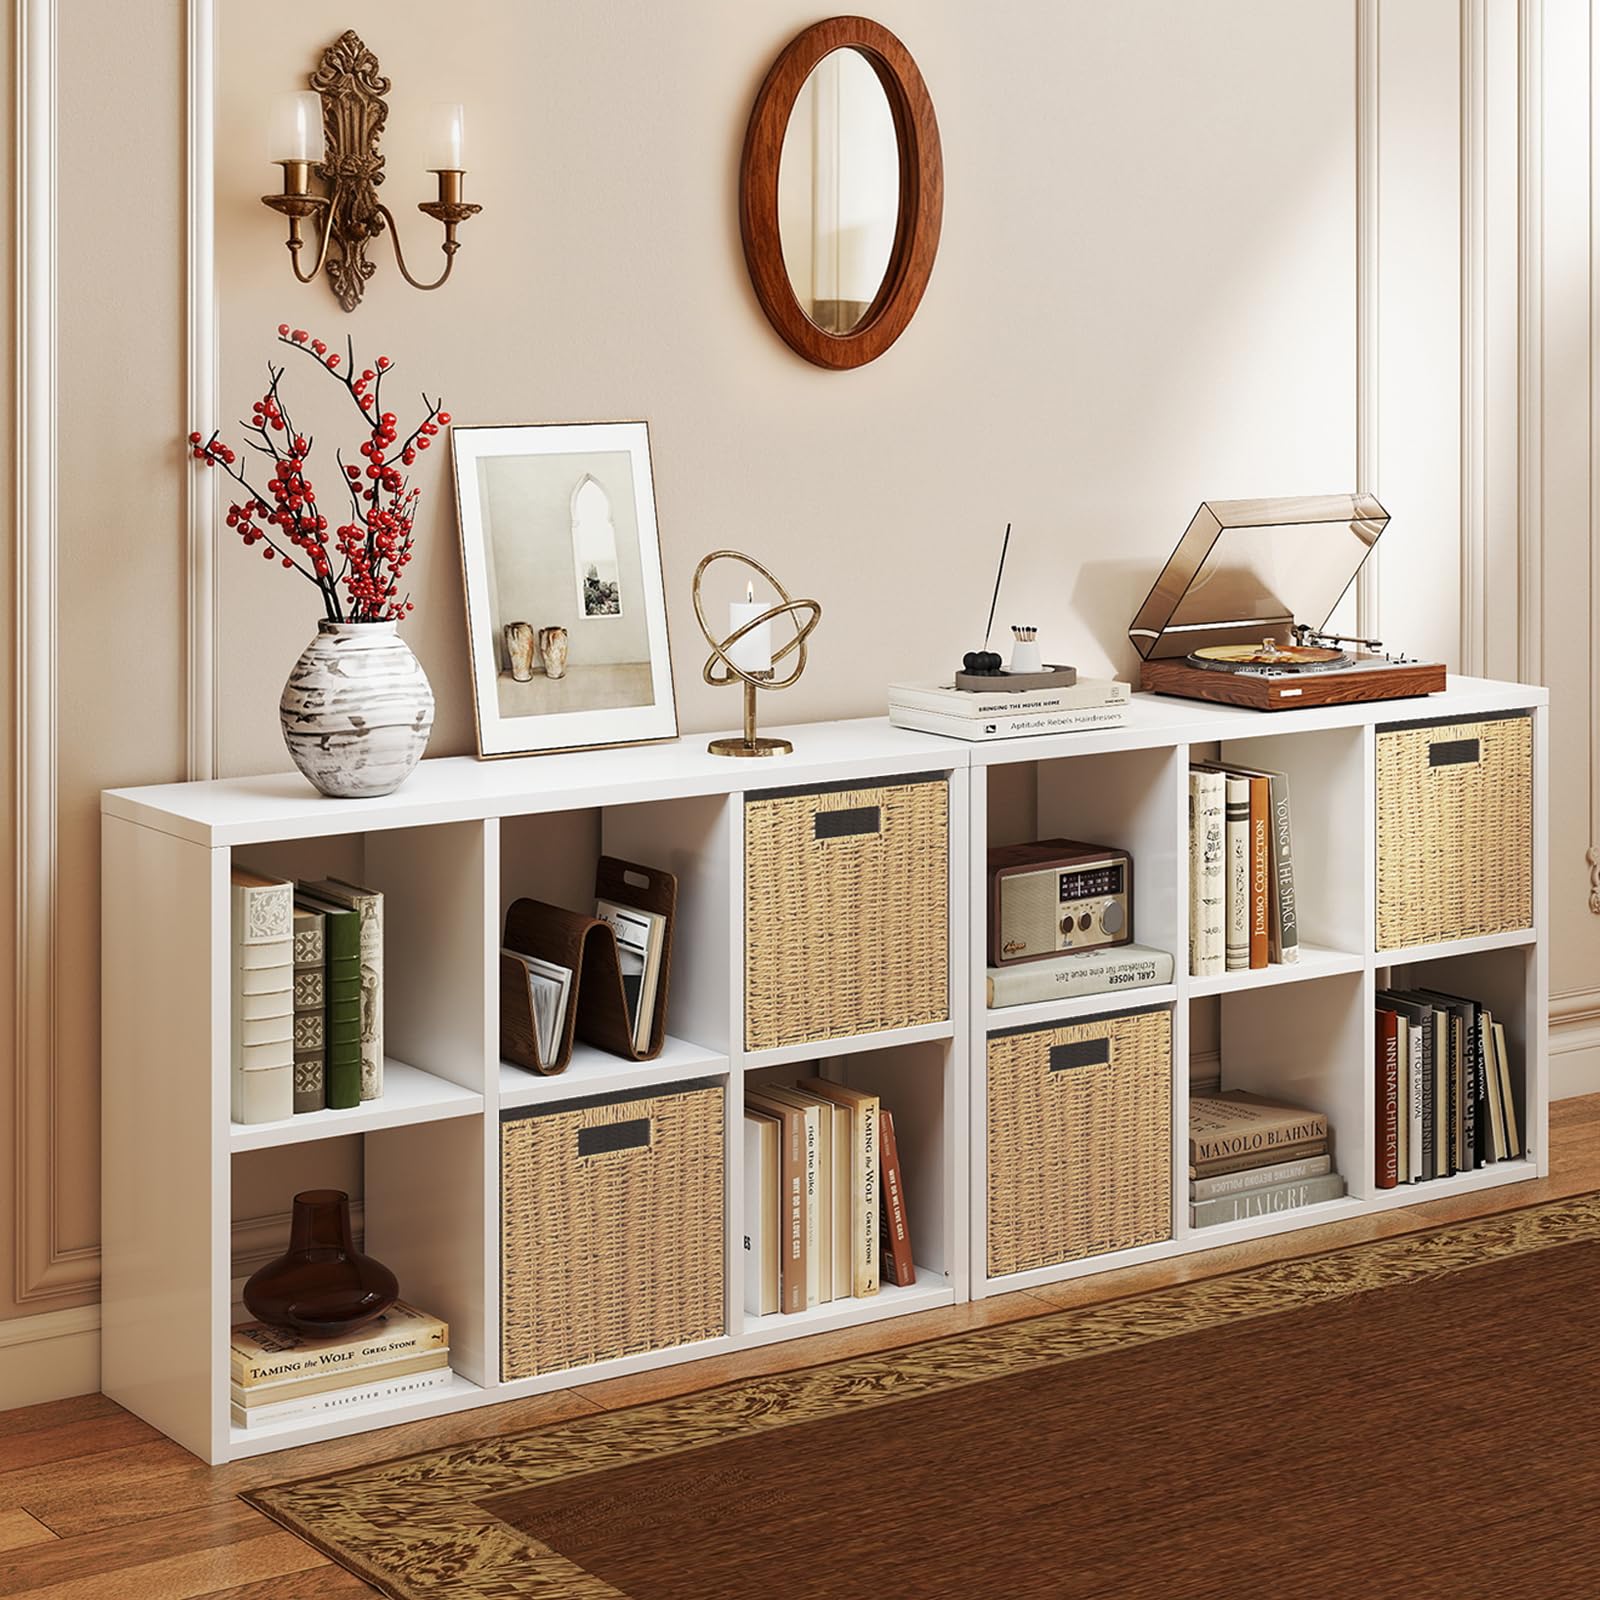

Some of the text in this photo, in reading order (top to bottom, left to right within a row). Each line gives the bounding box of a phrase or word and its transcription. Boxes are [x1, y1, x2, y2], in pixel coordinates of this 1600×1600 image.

[978, 704, 1008, 712] BRINGING
[1010, 720, 1046, 730] Aptitude
[1255, 819, 1266, 936] JUMBO COLLECTION
[1277, 798, 1295, 932] YOUNG THE SHACK
[1055, 972, 1069, 983] Zeit
[1070, 969, 1088, 978] neue
[1088, 967, 1104, 977] eine
[1108, 970, 1156, 985] CARL MOSER
[1117, 961, 1156, 972] Architektur
[1414, 1036, 1422, 1053] ART
[1463, 1026, 1473, 1075] urban
[1414, 1077, 1422, 1119] SURVIVAL
[1422, 1015, 1432, 1156] INNENARCHITEKTUR
[1467, 1080, 1473, 1099] an
[1386, 1037, 1397, 1179] INNENARCHITEKTUR
[1463, 1104, 1473, 1120] in
[865, 1104, 874, 1153] TAMING
[1199, 1120, 1324, 1159] MANOLO BLAHNÍK
[865, 1170, 874, 1204] WOLF
[792, 1220, 800, 1239] LOVE
[865, 1211, 873, 1265] GREG STONE
[250, 1362, 301, 1379] TAMING
[304, 1359, 318, 1369] the
[319, 1351, 355, 1365] WOLF
[361, 1345, 387, 1356] GREG
[388, 1339, 417, 1351] STONE
[324, 1380, 433, 1408] SELECTED STORIES
